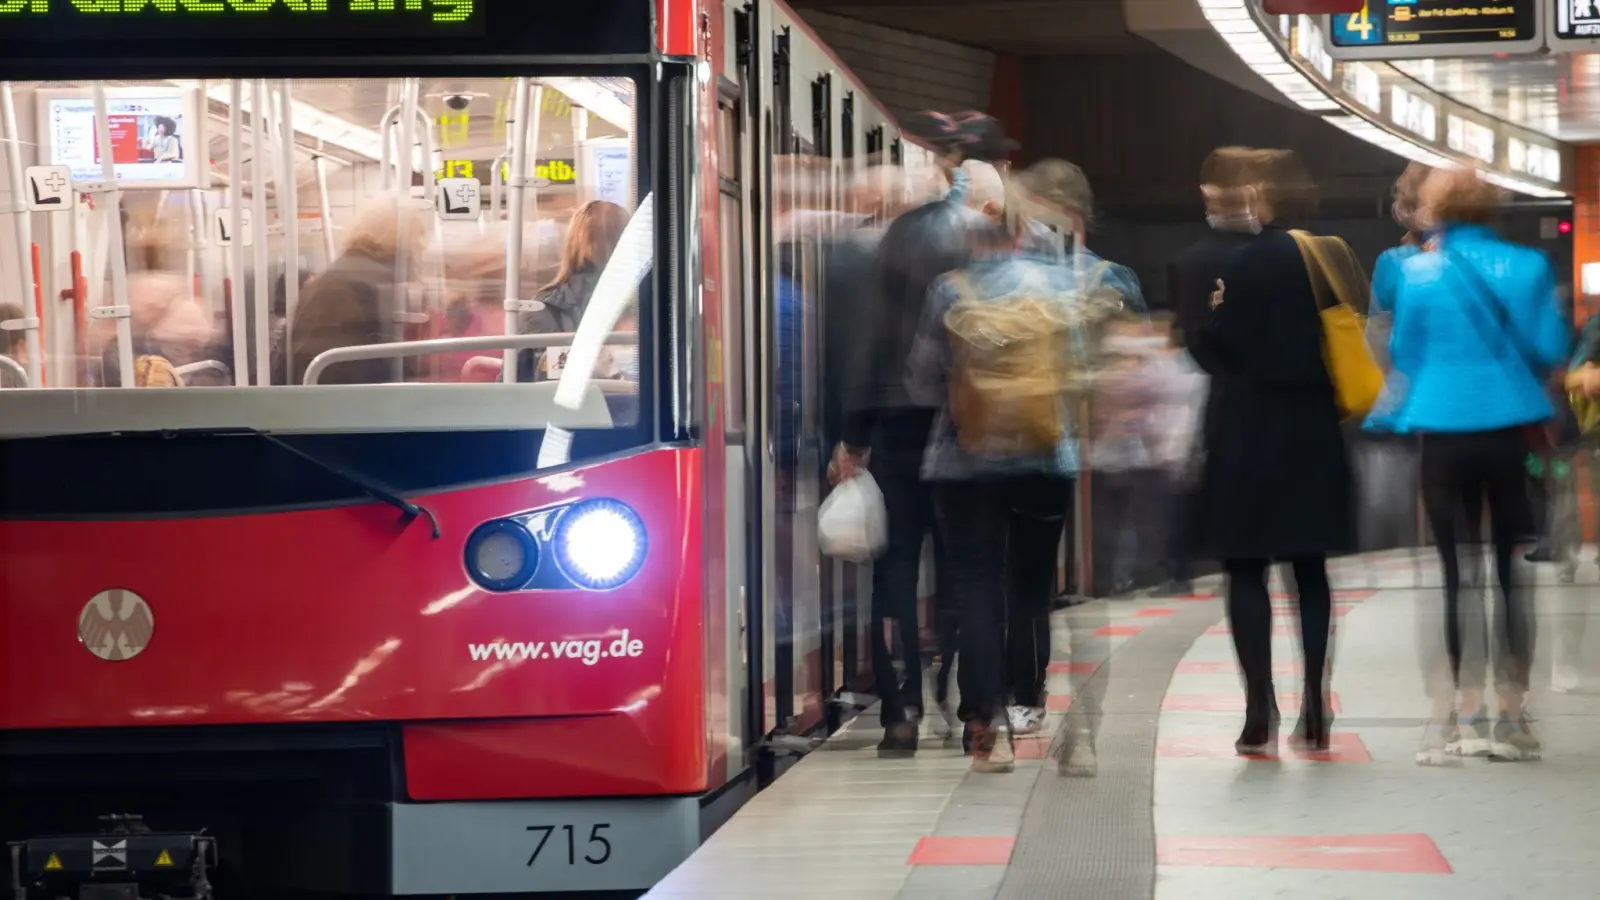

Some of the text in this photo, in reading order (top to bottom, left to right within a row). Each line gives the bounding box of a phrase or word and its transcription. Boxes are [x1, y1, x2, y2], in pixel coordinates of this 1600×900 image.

[1346, 3, 1373, 40] 4
[468, 628, 644, 666] www.vag.de
[526, 823, 611, 867] 715
